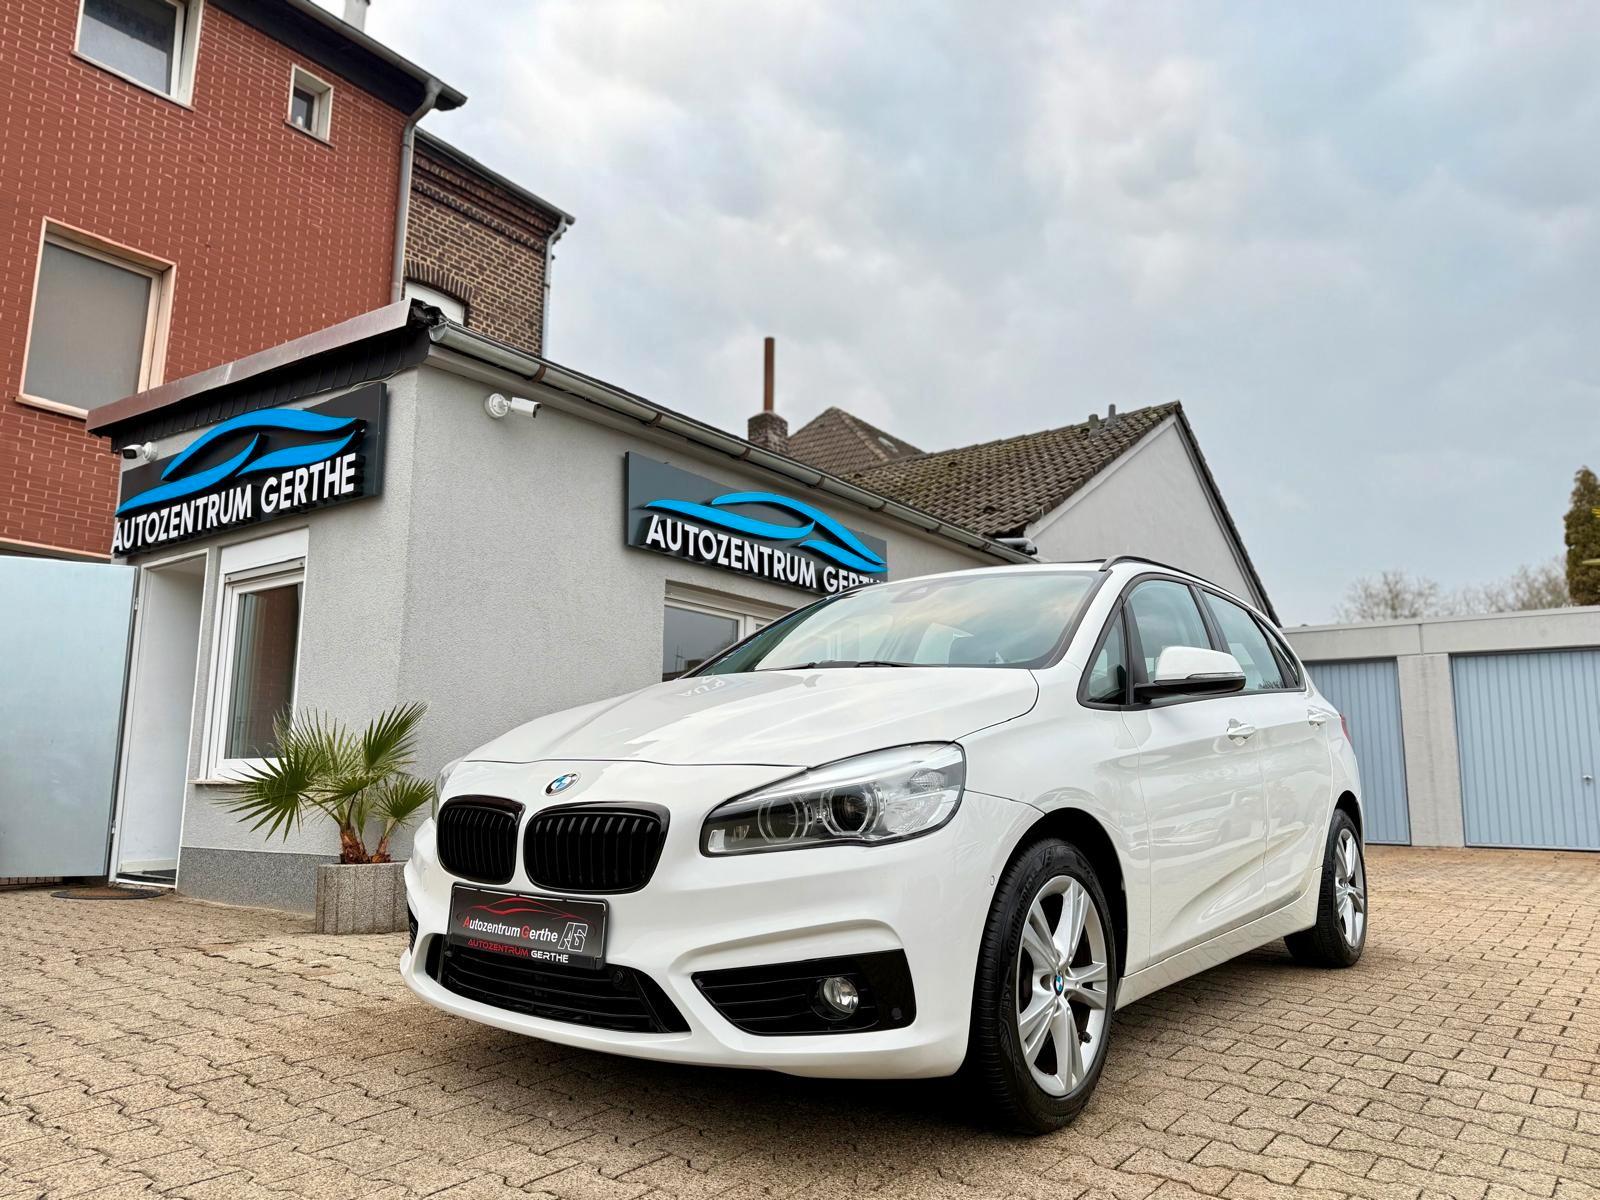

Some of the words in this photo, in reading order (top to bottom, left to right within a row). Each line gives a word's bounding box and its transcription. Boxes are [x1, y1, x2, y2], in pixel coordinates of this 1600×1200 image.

[111, 484, 252, 554] AUTOZENTRUM
[260, 453, 356, 514] GERTHE
[645, 514, 817, 589] AUTOZENTRUM
[473, 938, 529, 957] AUTOZENTRUM
[531, 950, 569, 963] GERTHE
